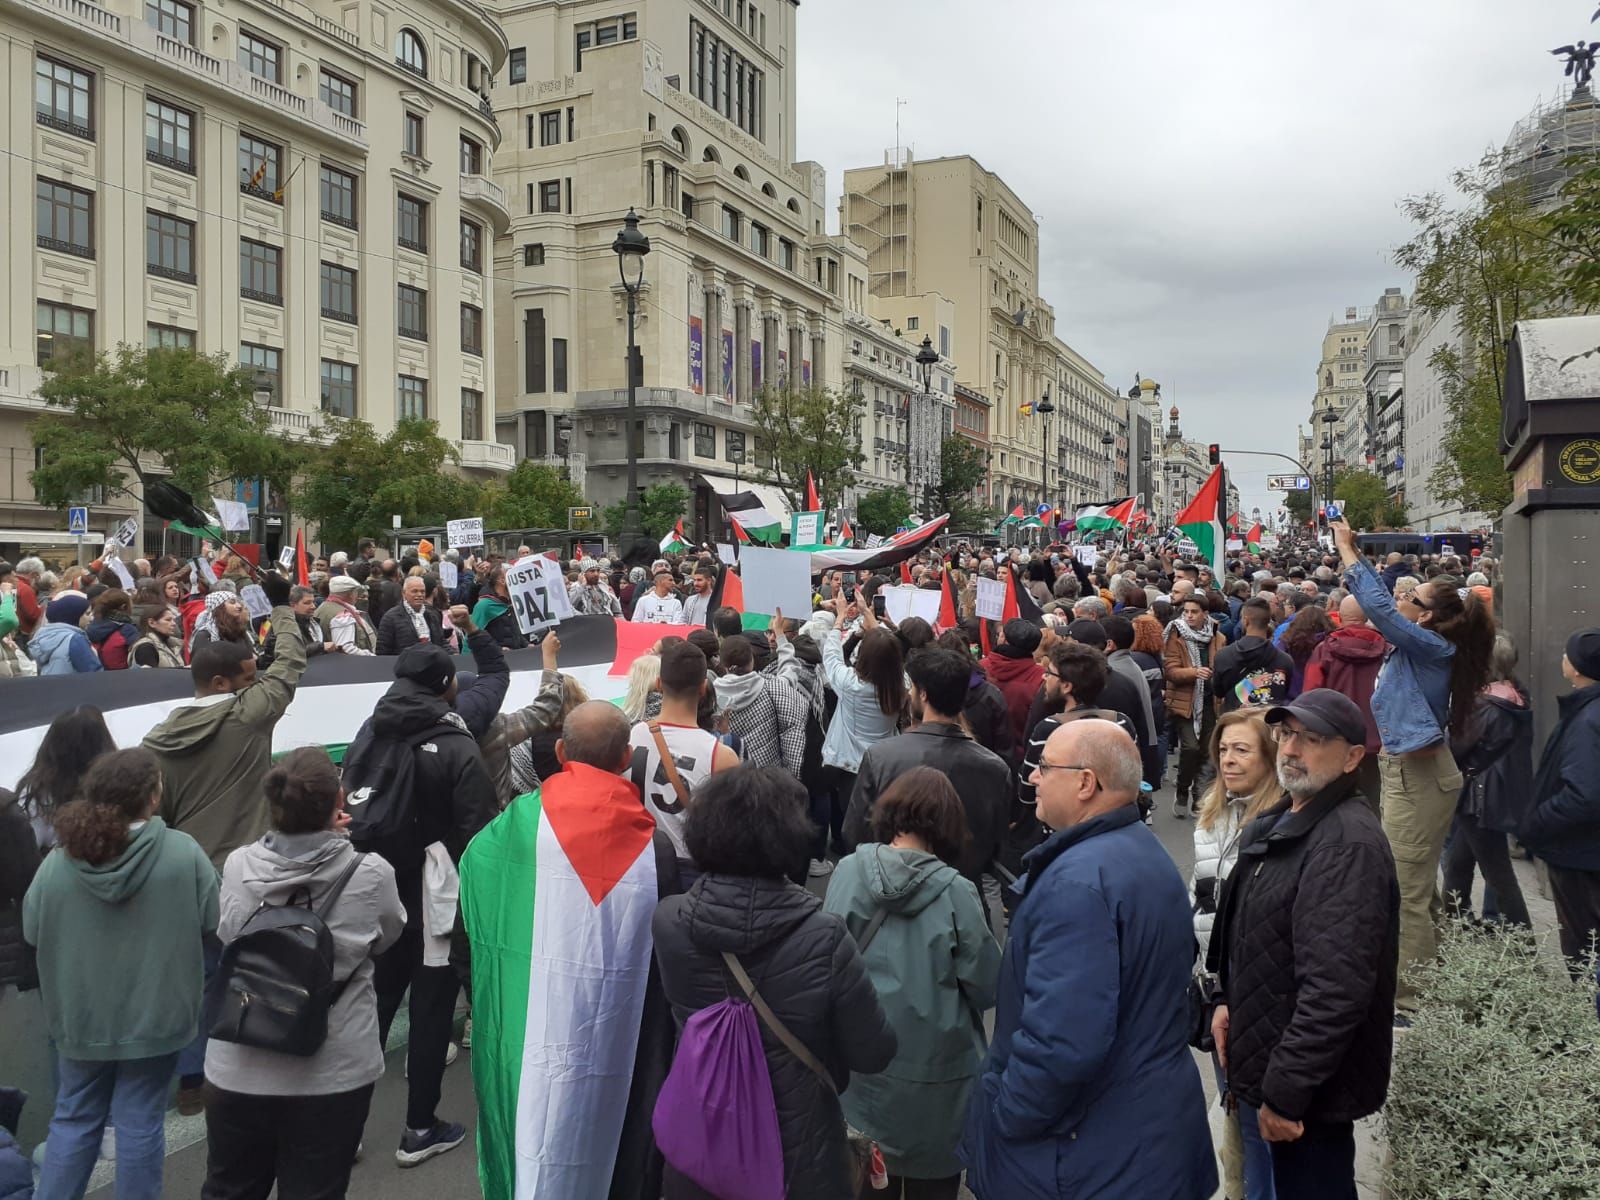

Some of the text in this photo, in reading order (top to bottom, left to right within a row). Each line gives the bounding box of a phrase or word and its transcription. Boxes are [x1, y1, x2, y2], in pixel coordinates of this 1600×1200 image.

[449, 535, 458, 545] DE
[507, 567, 543, 587] JUSTA
[512, 586, 556, 629] PAZ
[620, 746, 697, 815] 15
